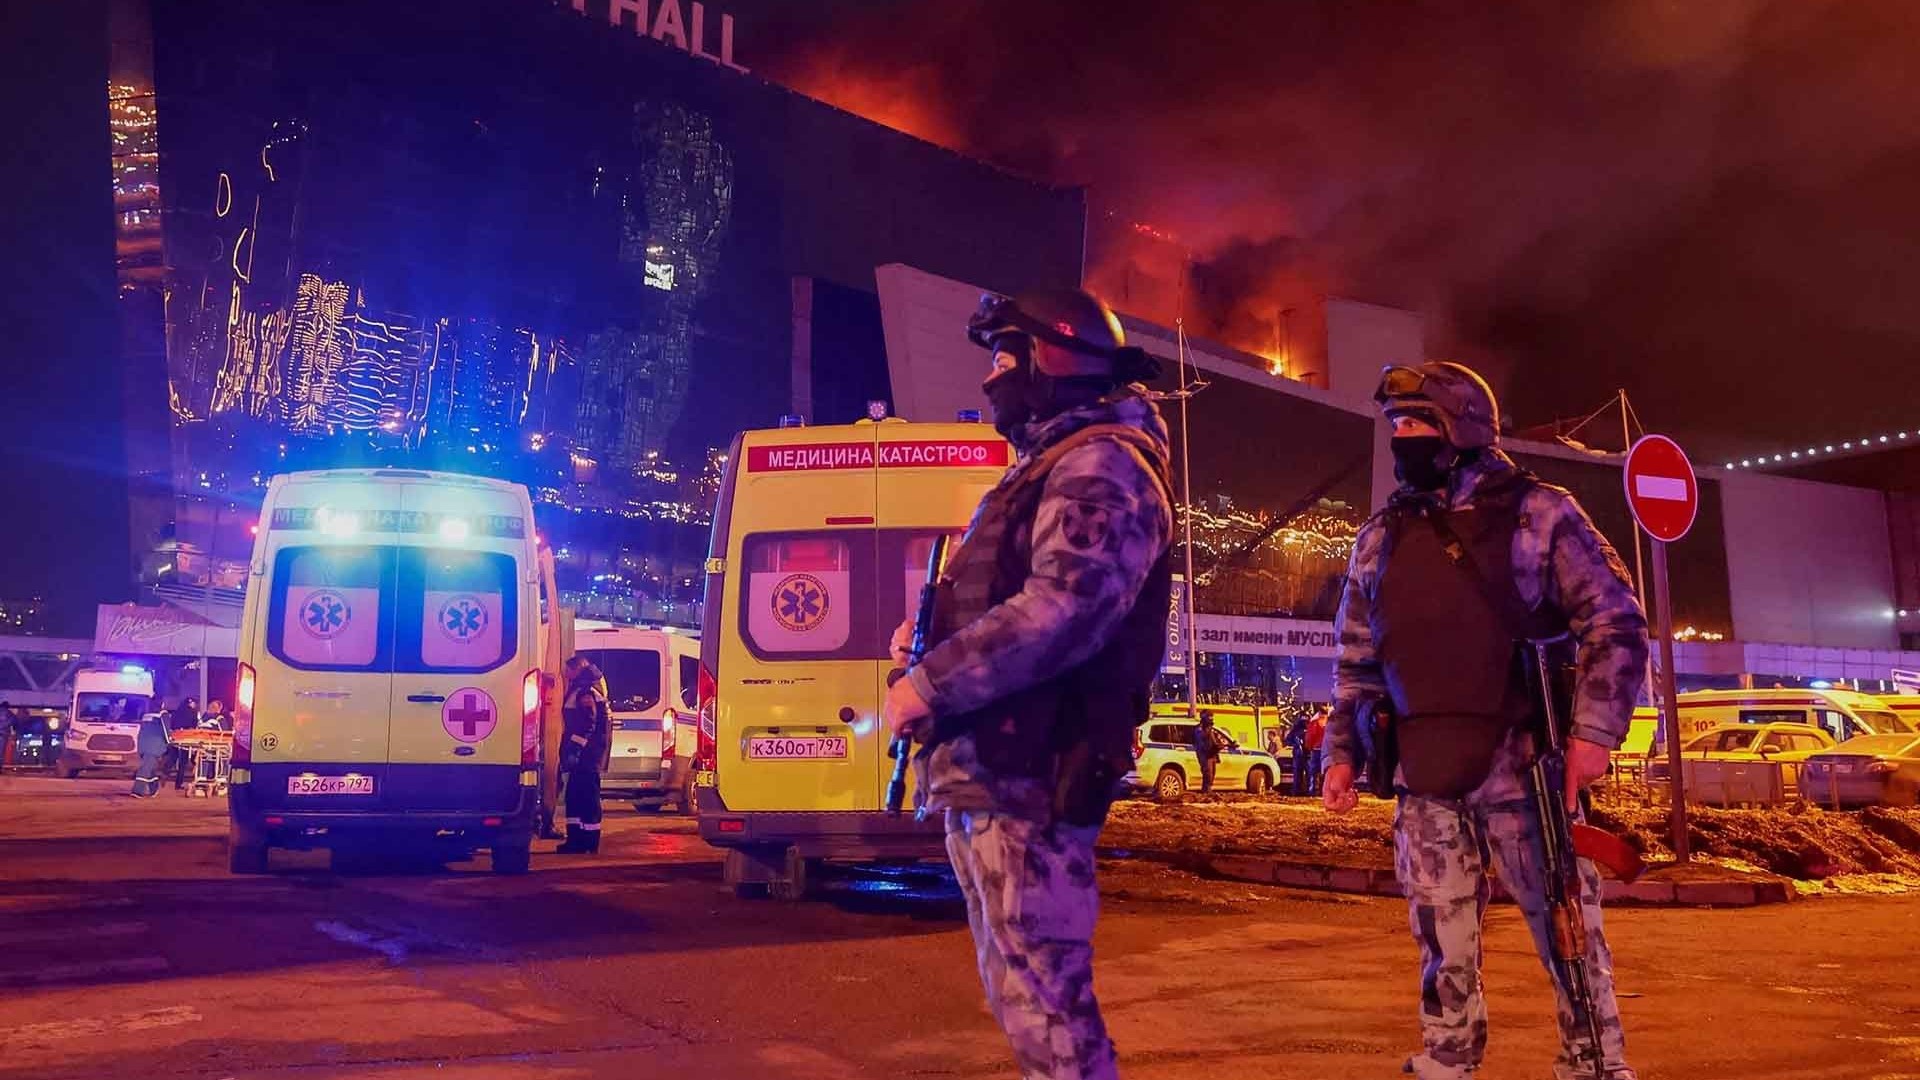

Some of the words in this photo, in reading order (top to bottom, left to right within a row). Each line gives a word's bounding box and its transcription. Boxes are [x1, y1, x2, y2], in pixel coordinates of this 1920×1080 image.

[608, 0, 750, 74] HALL
[768, 446, 873, 468] МЕДИЦИНА
[879, 445, 988, 463] КАТАСТРОФ
[1169, 587, 1181, 645] ЭКСПО
[1200, 629, 1229, 642] зал
[1233, 630, 1283, 646] имени
[1170, 651, 1182, 661] 3
[262, 737, 275, 746] 12
